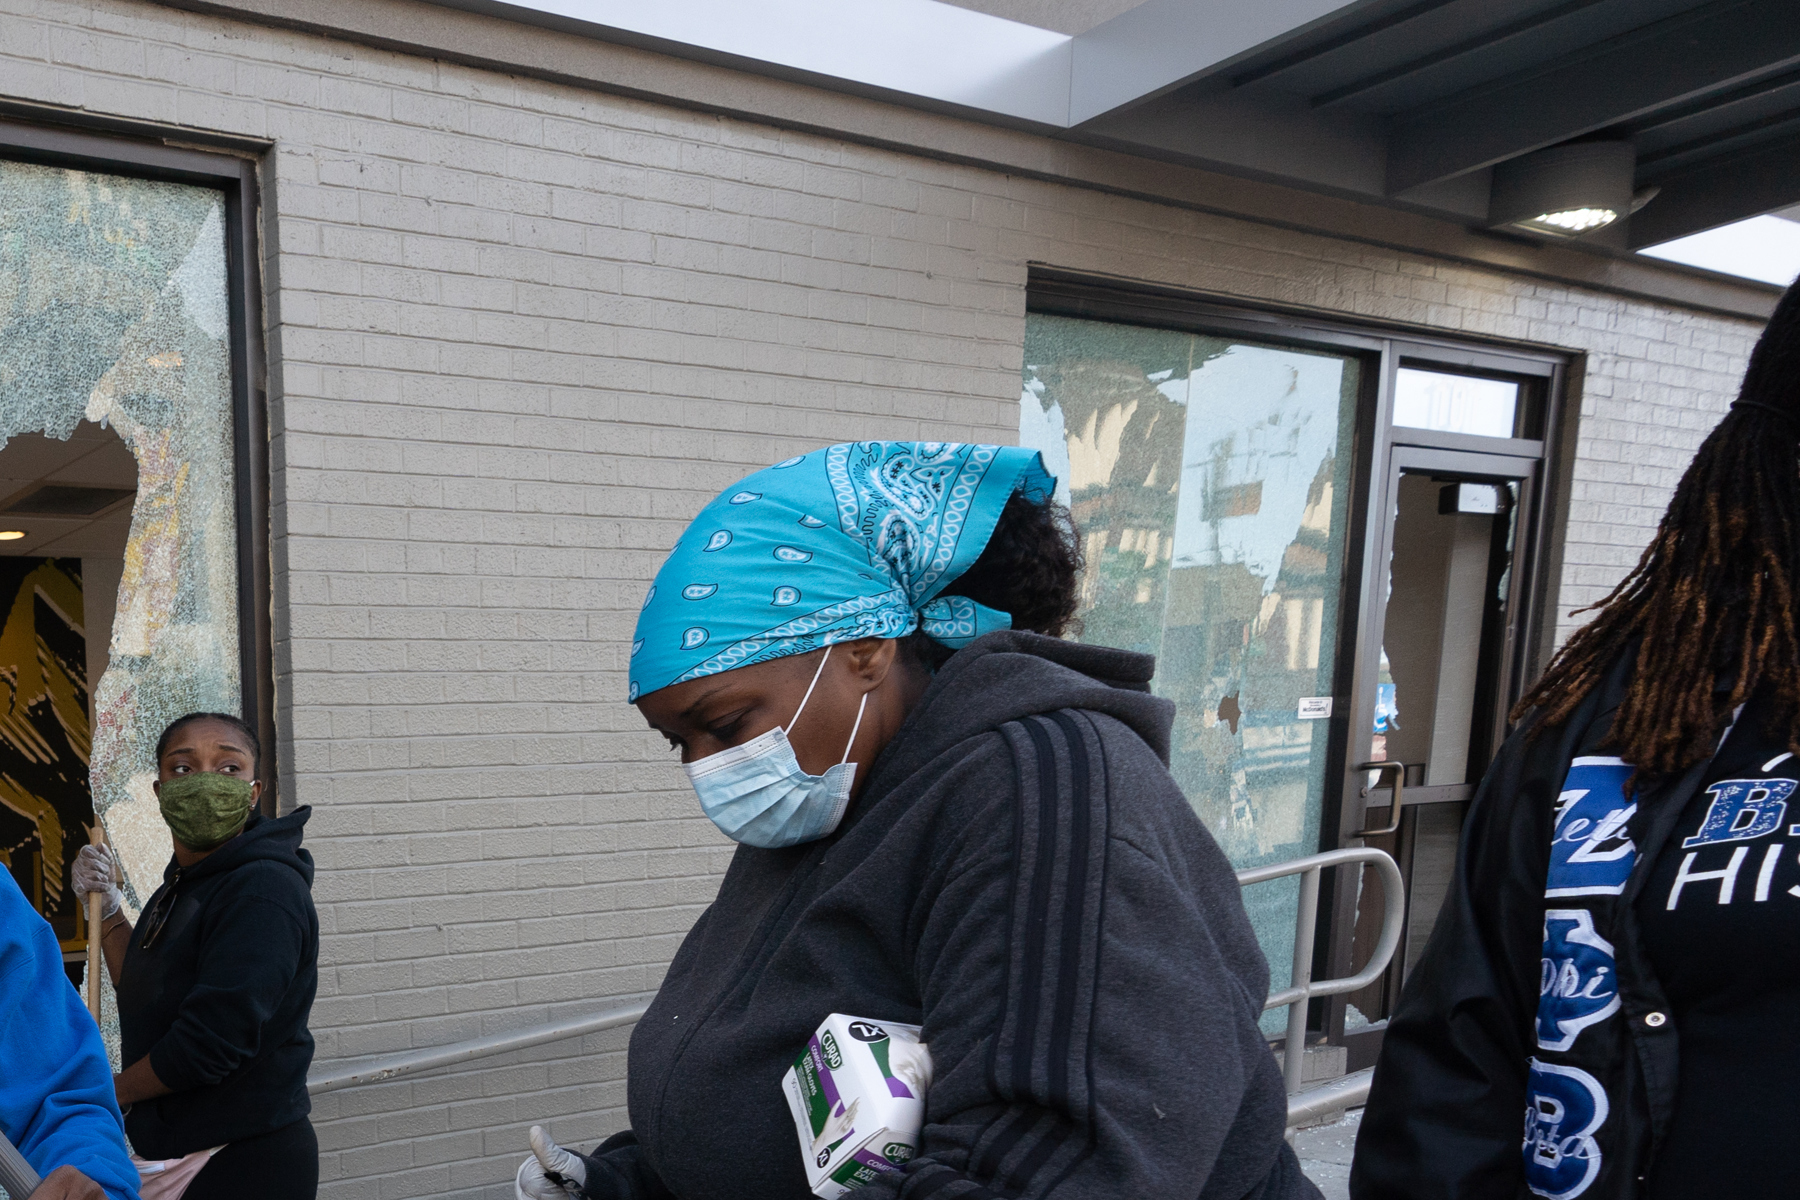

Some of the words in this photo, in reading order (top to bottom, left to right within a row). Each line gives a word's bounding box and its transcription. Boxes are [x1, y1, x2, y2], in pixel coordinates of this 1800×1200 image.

[1681, 778, 1800, 849] B
[1666, 843, 1800, 911] HI
[822, 1033, 841, 1068] CURAD
